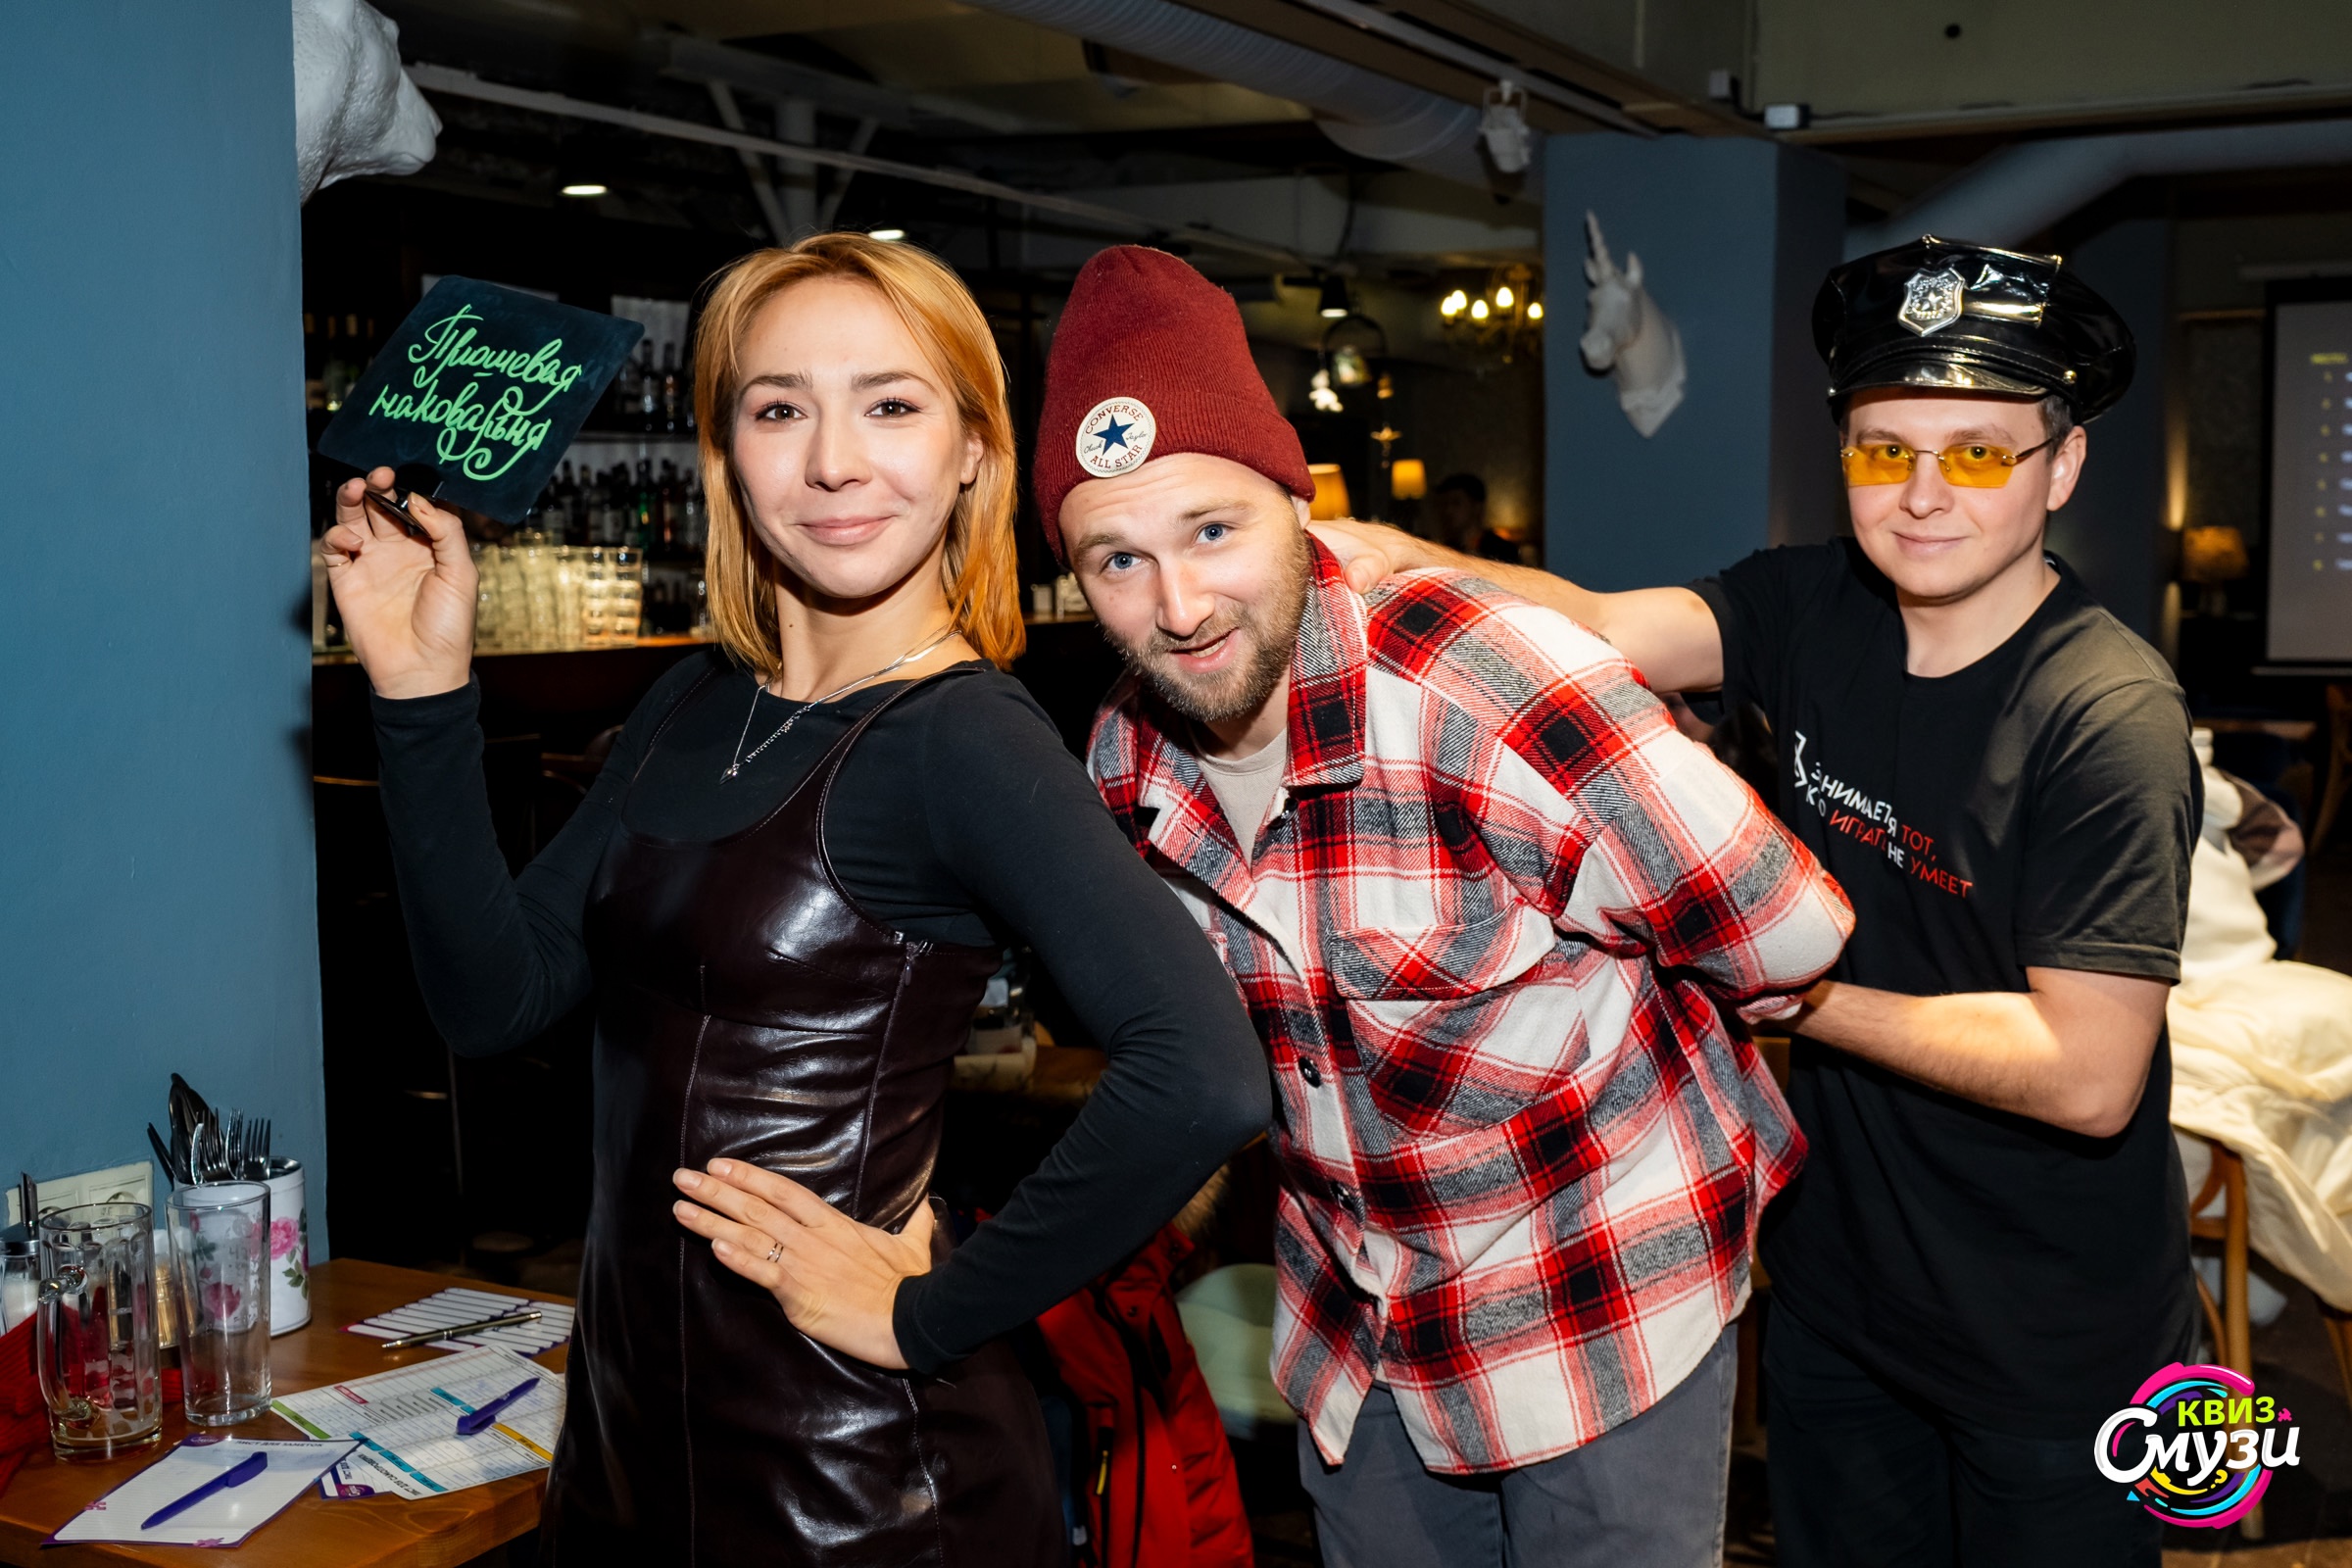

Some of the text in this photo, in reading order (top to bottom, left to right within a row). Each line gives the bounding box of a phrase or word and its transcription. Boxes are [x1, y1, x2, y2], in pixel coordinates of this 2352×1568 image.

[368, 379, 552, 481] наковальня
[1085, 405, 1144, 435] CONVERSE
[1090, 444, 1143, 469] ALL STAR
[1805, 784, 1827, 817] КО
[1887, 841, 1904, 869] НЕ
[1911, 856, 1973, 899] УМЕЕТ
[1901, 823, 1937, 862] ТОТ,
